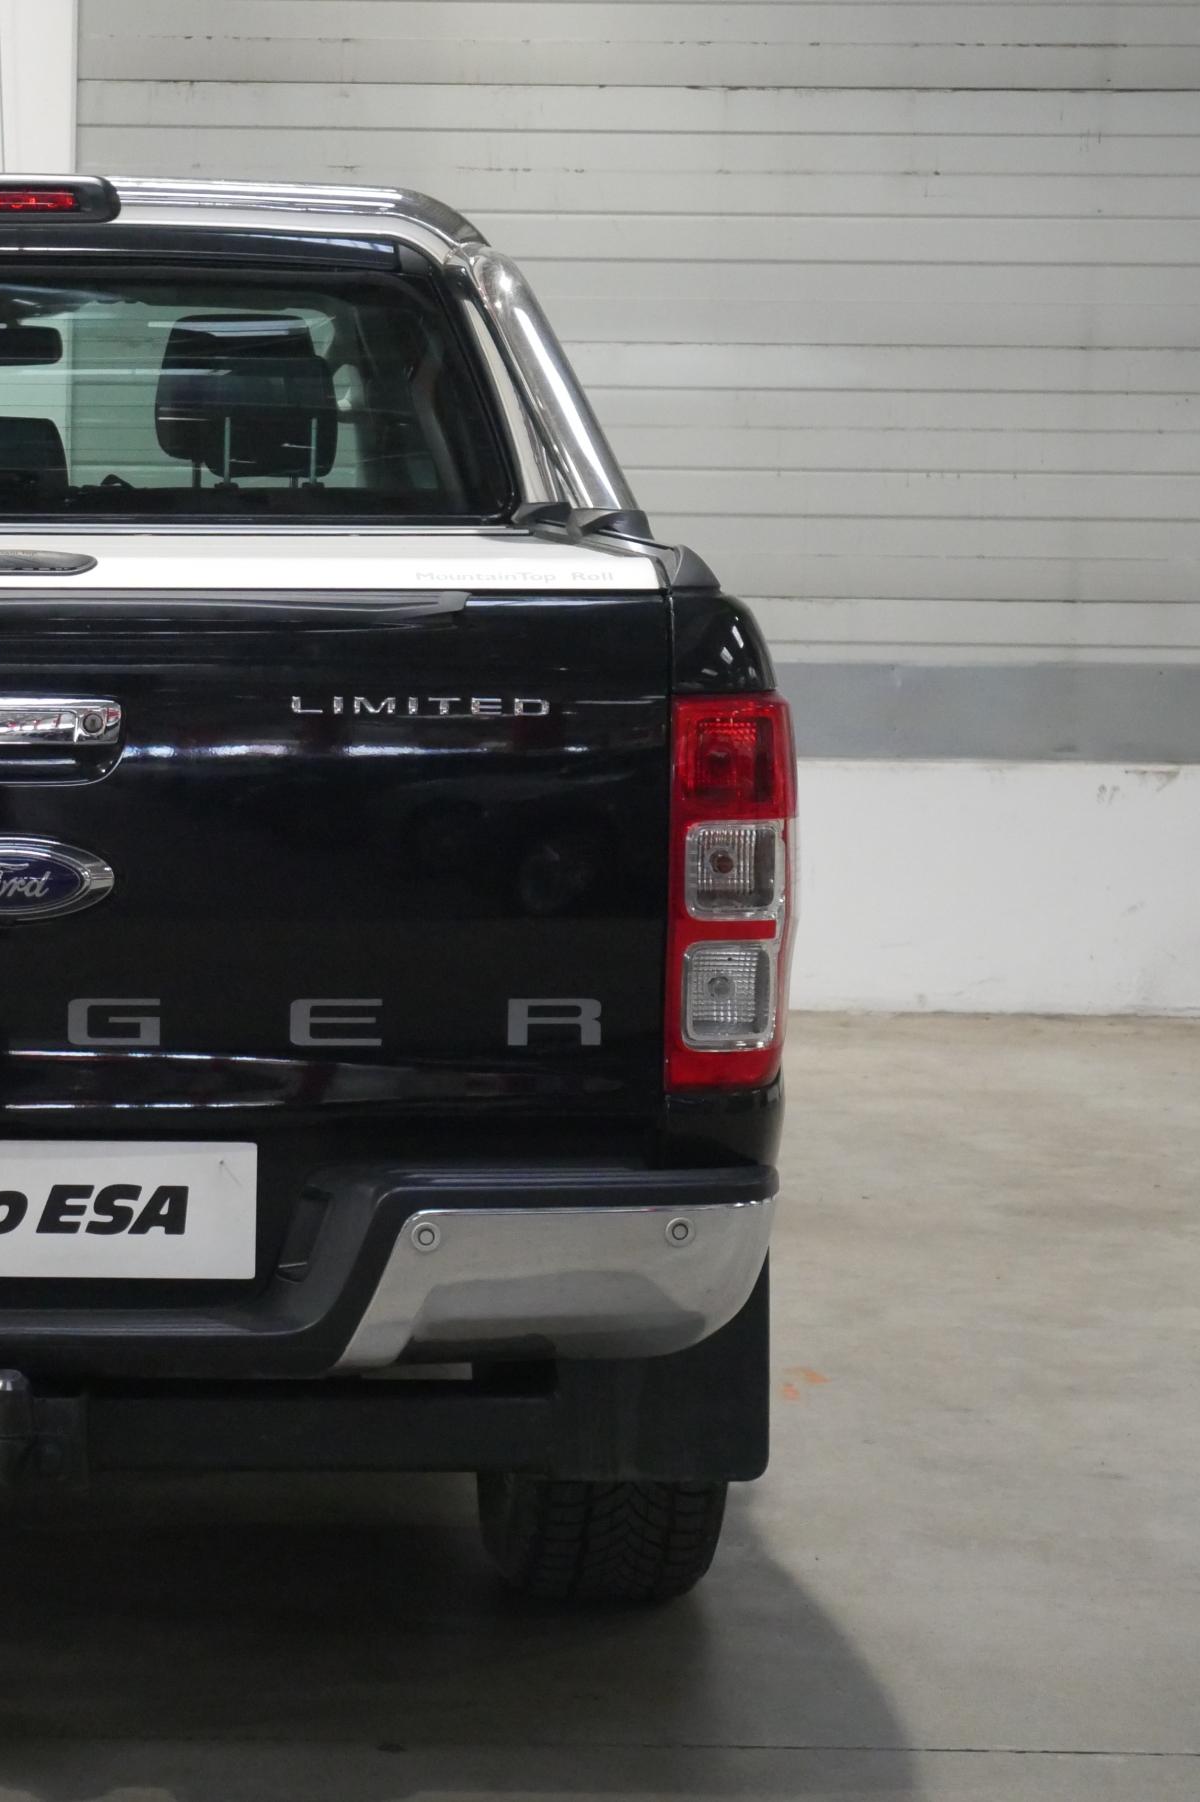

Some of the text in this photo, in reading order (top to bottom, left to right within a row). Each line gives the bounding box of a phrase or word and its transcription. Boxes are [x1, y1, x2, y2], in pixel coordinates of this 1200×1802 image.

[415, 571, 614, 584] MountainTop Roll
[291, 695, 550, 716] LIMITED
[35, 1183, 189, 1236] ESA
